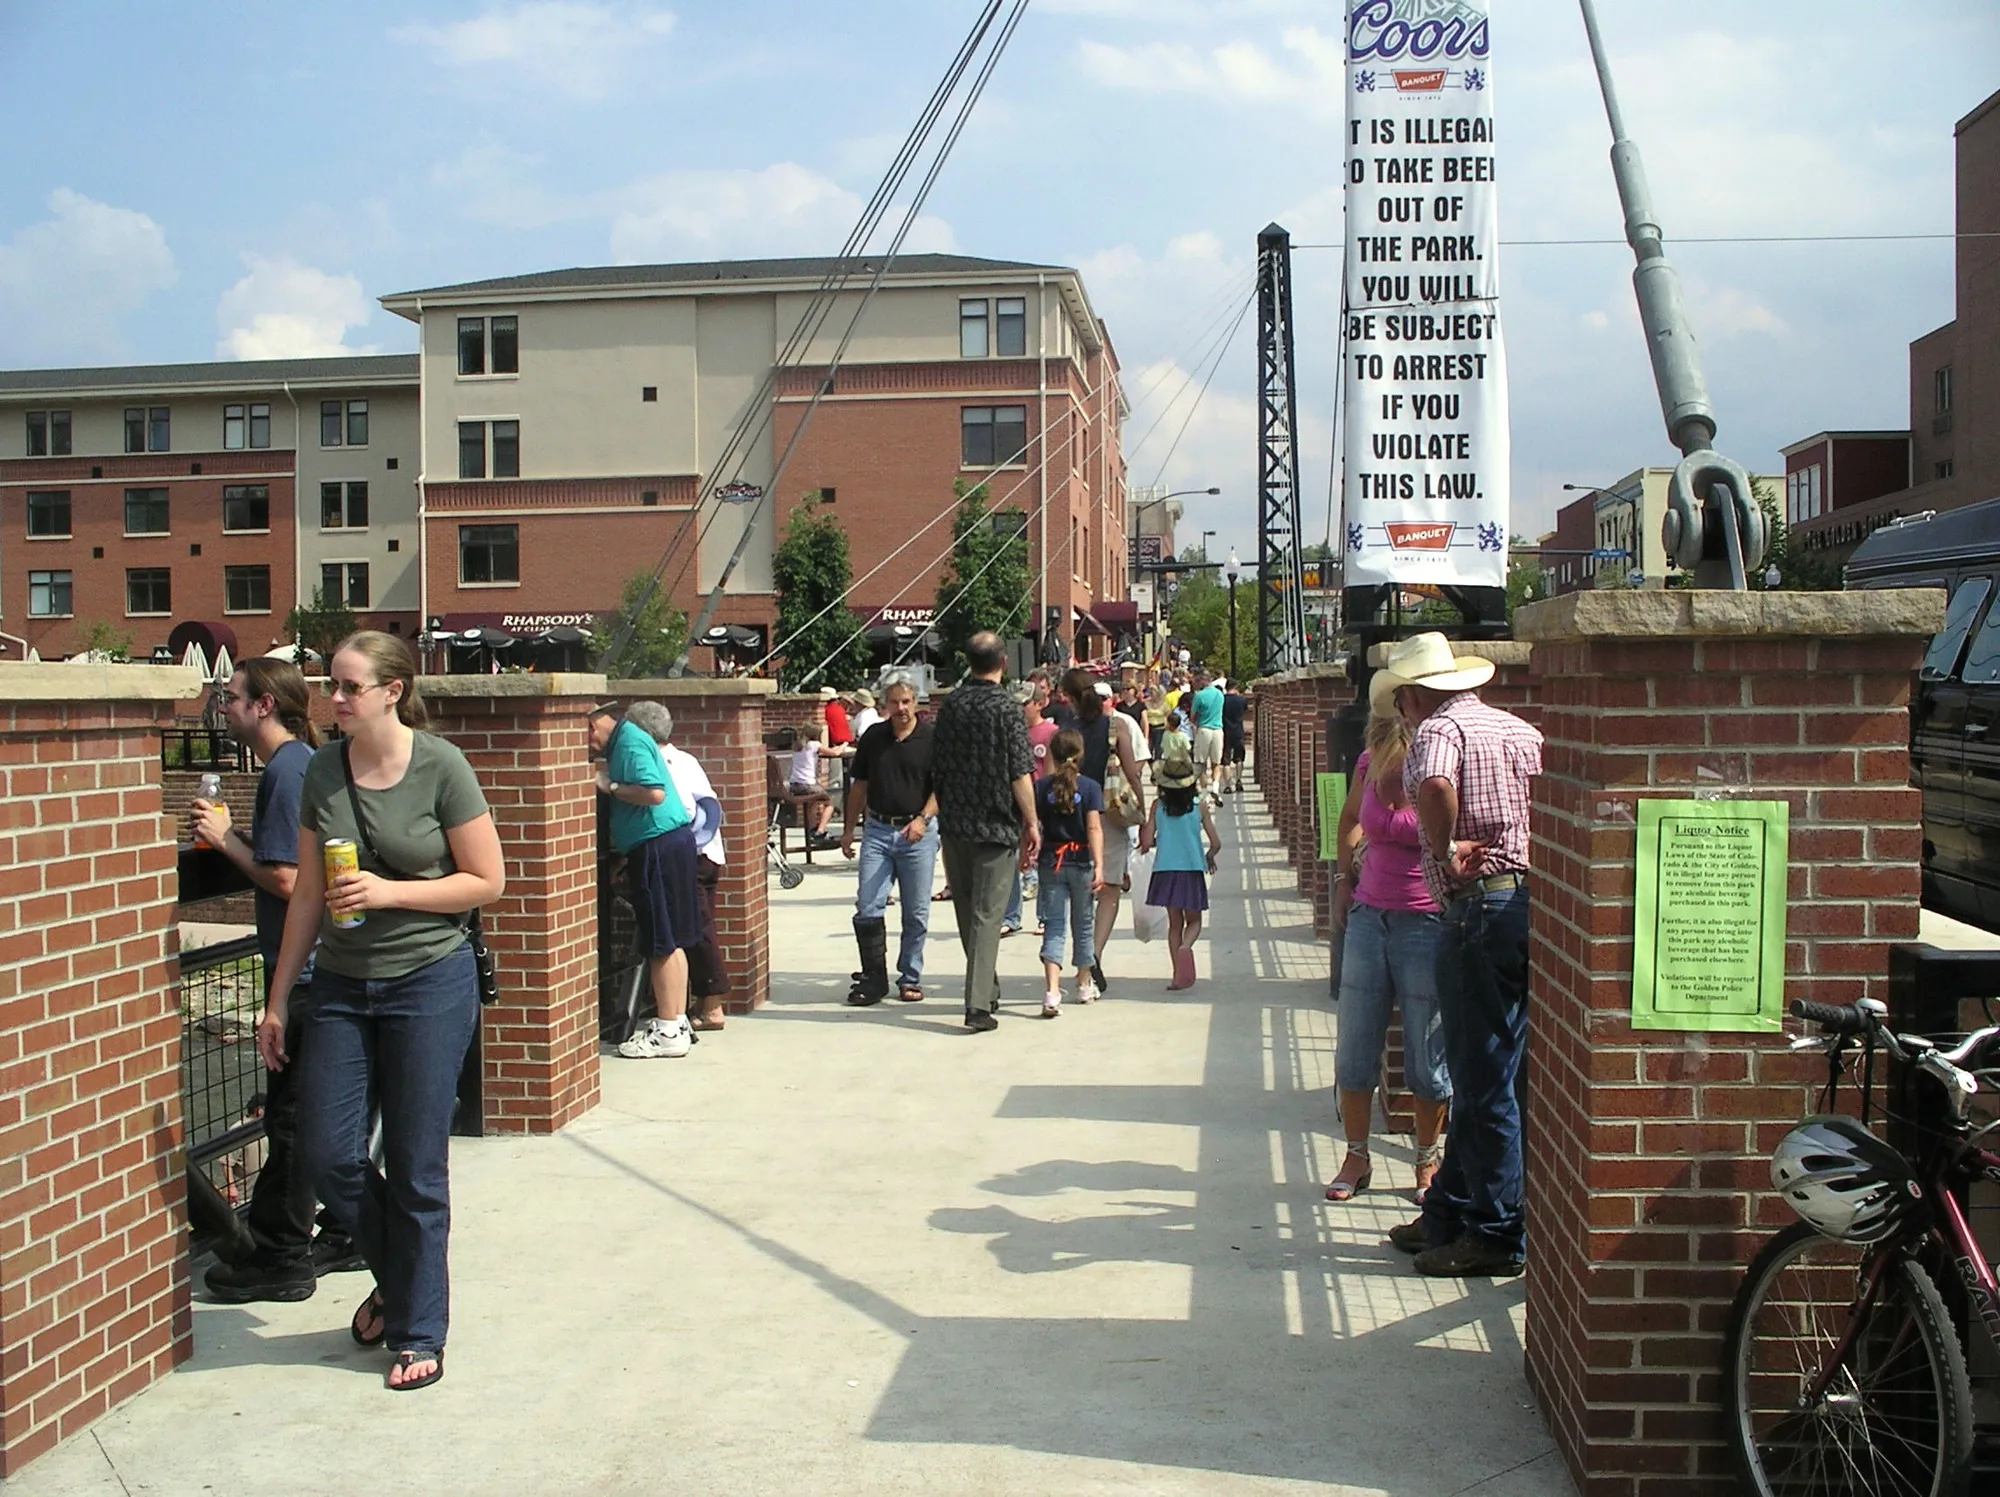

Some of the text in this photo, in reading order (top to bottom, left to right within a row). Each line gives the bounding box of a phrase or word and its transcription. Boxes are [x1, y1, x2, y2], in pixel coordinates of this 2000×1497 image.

[1351, 0, 1490, 58] Coors
[1401, 72, 1442, 87] BANQUET
[1350, 120, 1361, 144] T
[1371, 119, 1395, 144] IS
[1350, 158, 1364, 184] O
[1374, 158, 1433, 184] TAKE
[1378, 196, 1464, 222] OUT OF
[1358, 236, 1483, 262] THE PARK.
[1362, 275, 1478, 302] YOU WILL
[1350, 314, 1496, 341] BE SUBJECT
[1355, 354, 1487, 380] TO ARREST
[1382, 394, 1460, 420] IF YOU
[1372, 434, 1470, 460] VIOLATE
[1360, 474, 1483, 500] THIS LAW.
[1397, 528, 1448, 544] BANQUET
[882, 609, 935, 620] RHAPS
[1675, 824, 1749, 836] Liquor Notice
